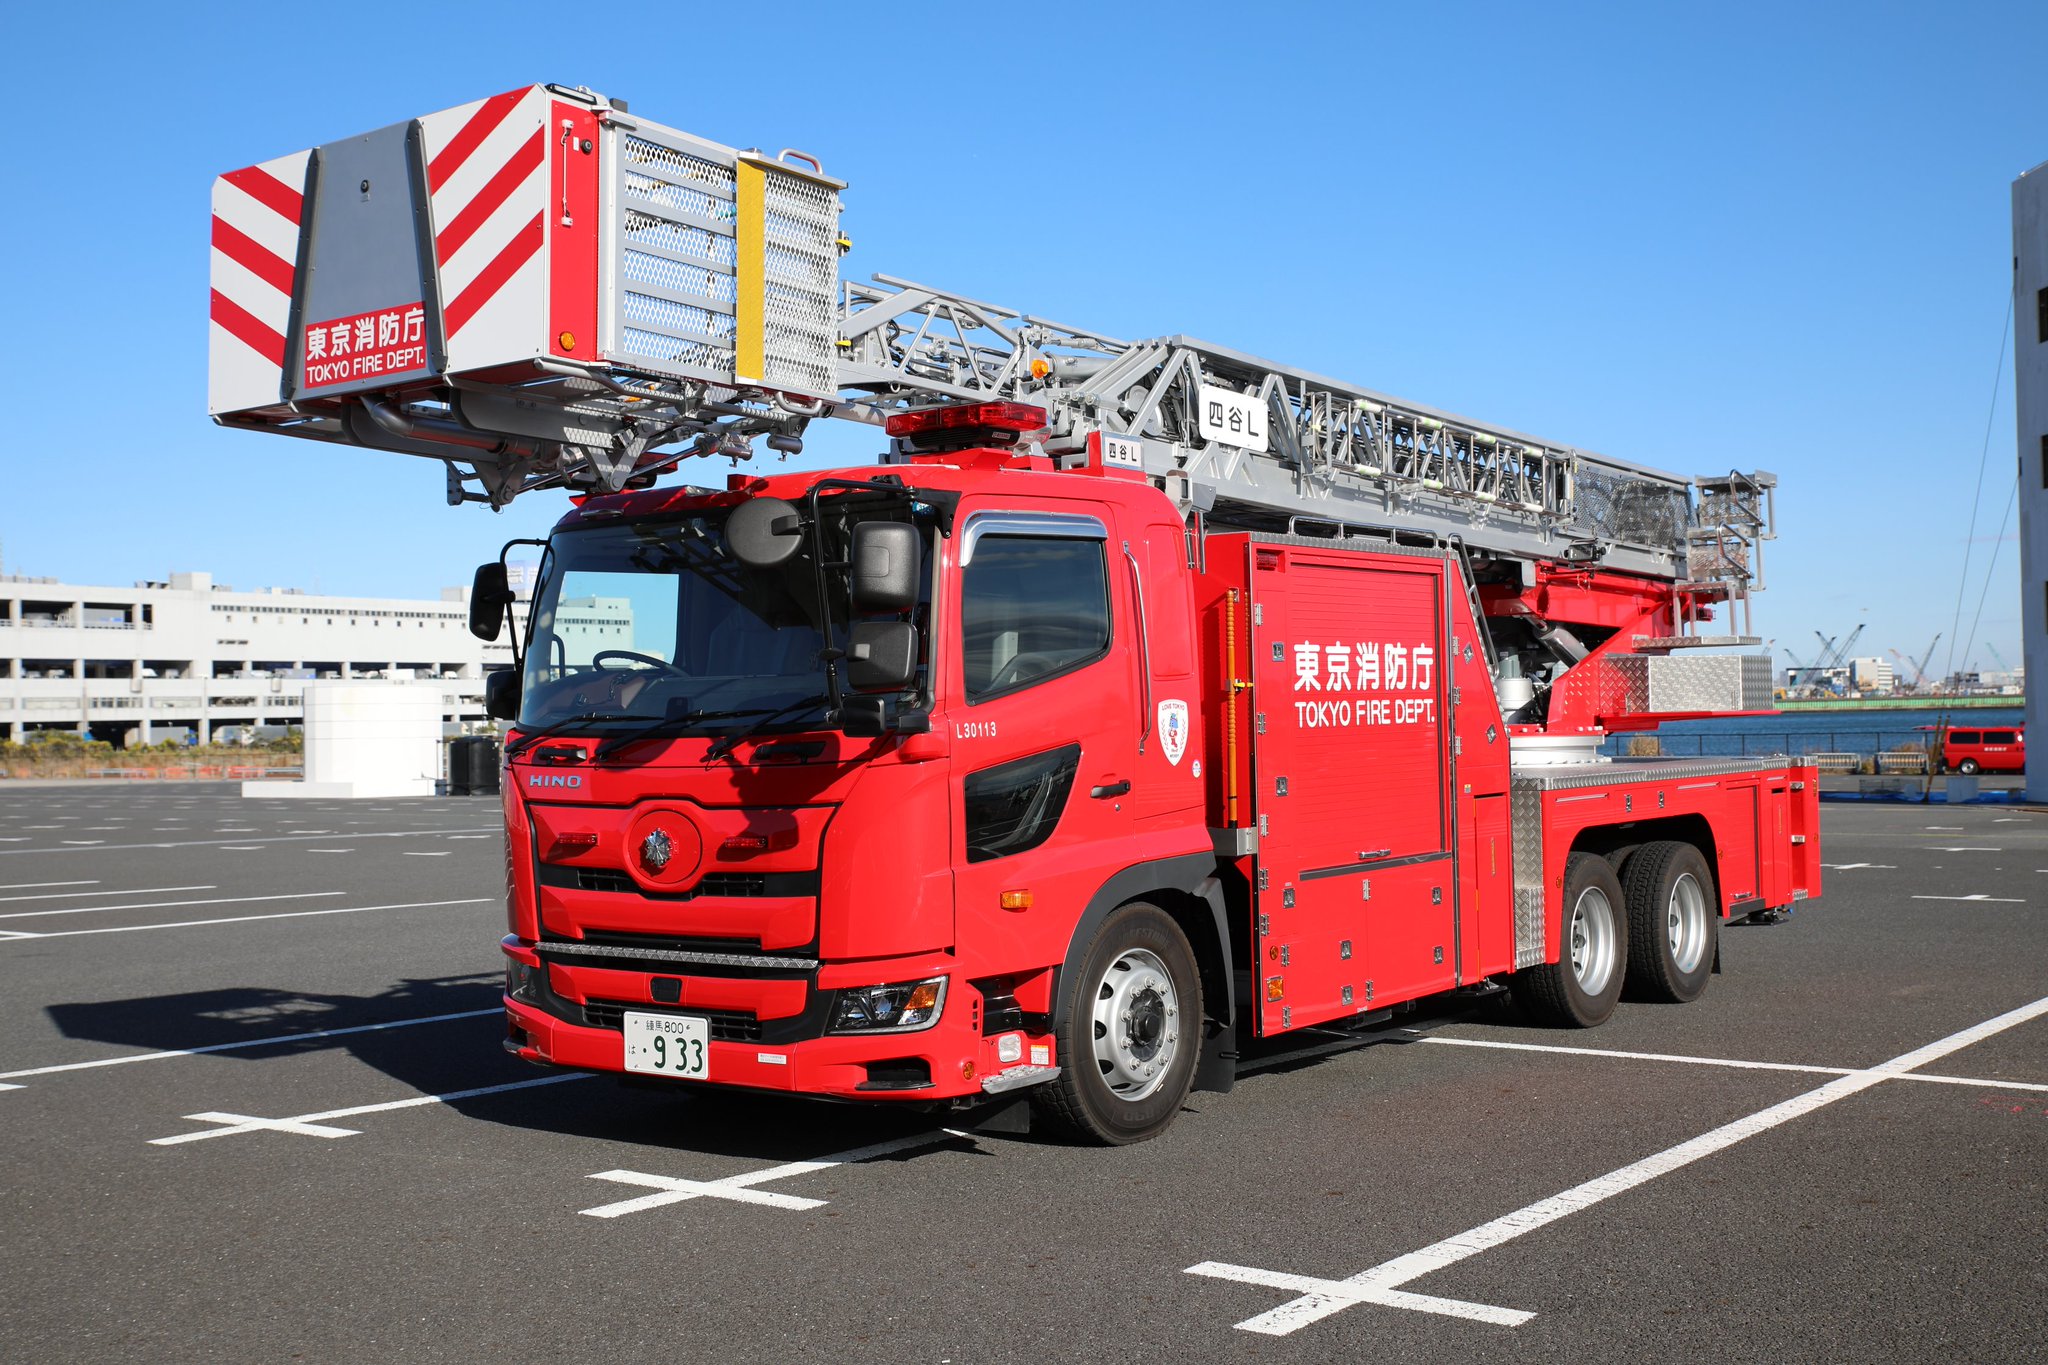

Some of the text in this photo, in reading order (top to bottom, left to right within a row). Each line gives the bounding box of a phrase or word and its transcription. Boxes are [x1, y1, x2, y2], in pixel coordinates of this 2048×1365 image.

[306, 306, 425, 361] 東京消防庁
[306, 346, 424, 384] TOKYO FIRE DEPT.
[1209, 401, 1260, 437] 四谷L
[1293, 640, 1434, 692] 東京消防庁
[1161, 703, 1185, 711] LOVE TOKYO
[1294, 698, 1436, 728] TOKYO FIRE DEPT.
[956, 721, 997, 739] L30113
[529, 775, 582, 788] HINO
